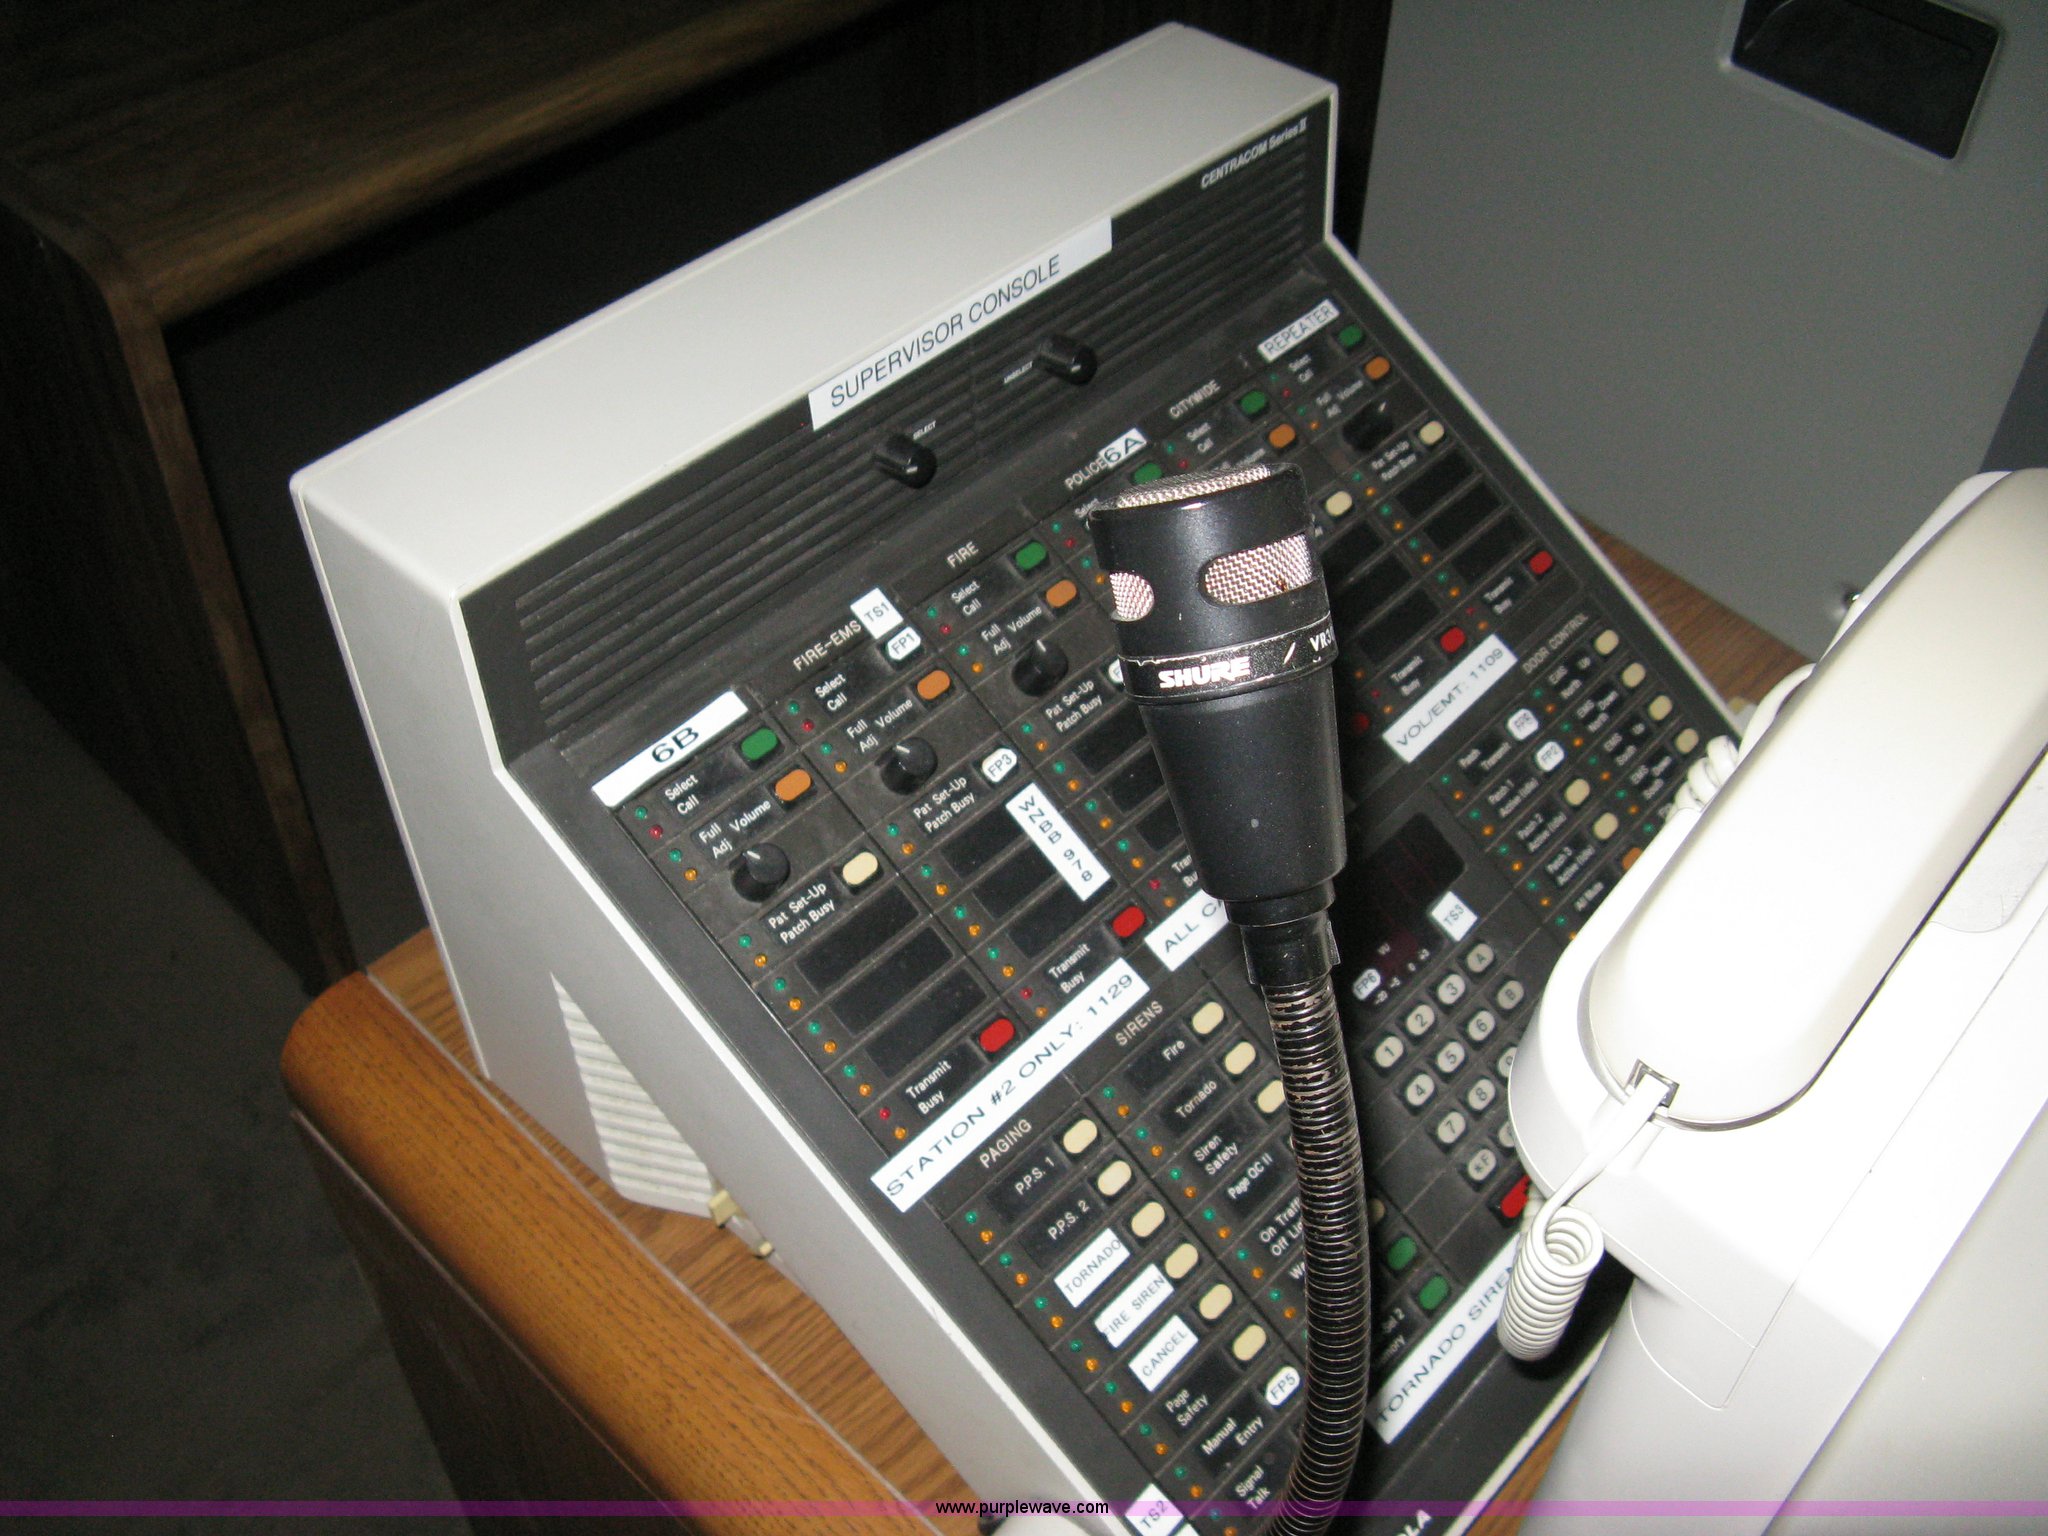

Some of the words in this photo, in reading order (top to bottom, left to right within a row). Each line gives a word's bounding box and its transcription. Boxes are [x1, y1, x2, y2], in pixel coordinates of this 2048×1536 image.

[1201, 141, 1268, 189] CENTRACOM
[1268, 127, 1299, 149] Series
[831, 313, 963, 408] SUPERVISOR
[969, 254, 1060, 324] CONSOLE
[1264, 305, 1334, 355] REPEATER
[1169, 379, 1221, 419] CITYWIDE
[1064, 457, 1108, 490] POLICE
[1104, 437, 1142, 463] 6A
[946, 541, 979, 568] FIRE
[951, 580, 981, 604] Select
[962, 598, 982, 617] Call
[864, 601, 890, 623] TS1
[981, 623, 1001, 643] Full
[1007, 604, 1043, 634] Volume
[793, 620, 862, 672] FIRE-EMS
[891, 632, 916, 655] FP1
[993, 637, 1012, 656] Adj
[1522, 646, 1549, 674] DOOR
[1549, 613, 1589, 650] CONTROL
[815, 673, 847, 699] Select
[1158, 656, 1250, 689] SHURE
[827, 692, 848, 712] Call
[1045, 701, 1064, 719] Pat
[1063, 679, 1095, 707] Set-Up
[1056, 709, 1083, 733] Patch
[1080, 693, 1104, 715] Busy
[1397, 684, 1470, 746] VOL/EMT:
[1470, 648, 1504, 680] 1109
[847, 719, 868, 740] Full
[875, 698, 914, 729] Volume
[651, 726, 699, 763] 6B
[859, 733, 879, 754] Adj
[988, 754, 1013, 777] FP3
[664, 774, 699, 801] Select
[914, 803, 934, 820] Pat
[933, 775, 968, 804] Set-Up
[677, 795, 699, 815] Call
[924, 807, 953, 833] Patch
[950, 791, 976, 817] Busy
[698, 823, 722, 844] Full
[729, 800, 771, 832] Volume
[712, 838, 733, 859] Adj
[1019, 795, 1062, 844] WZBB
[1063, 848, 1093, 883] 978
[768, 912, 789, 929] Pat
[789, 882, 827, 914] Set-Up
[780, 919, 810, 944] Patch
[808, 899, 835, 923] Busy
[1444, 904, 1464, 926] TS3
[1165, 922, 1199, 953] ALL
[1049, 943, 1091, 979] Transmit
[1060, 971, 1085, 994] Busy
[1356, 972, 1377, 994] FP6
[1446, 982, 1458, 996] 3
[1115, 1001, 1164, 1047] SIRENS
[1415, 1013, 1428, 1027] 2
[1476, 1019, 1487, 1032] 6
[1162, 1039, 1186, 1061] Fire
[1445, 1050, 1457, 1064] 5
[886, 1107, 985, 1197] STATION
[990, 1079, 1016, 1106] #2
[1019, 1020, 1083, 1078] ONLY:
[1086, 973, 1133, 1017] 1129
[906, 1060, 952, 1099] Transmit
[1415, 1084, 1426, 1096] 4
[1476, 1087, 1488, 1101] 8
[917, 1090, 945, 1115] Busy
[1175, 1080, 1218, 1119] Tornado
[978, 1118, 1033, 1168] PAGING
[1446, 1120, 1456, 1134] 7
[1194, 1134, 1222, 1162] Siren
[1205, 1142, 1238, 1175] Safety
[1014, 1167, 1047, 1195] P.P.S.
[1045, 1156, 1055, 1168] 1
[1227, 1177, 1250, 1199] Page
[1048, 1211, 1079, 1240] P.P.S.
[1078, 1200, 1090, 1213] 2
[1259, 1226, 1278, 1243] On
[1271, 1236, 1290, 1256] Off
[1064, 1238, 1122, 1295] TORNADO
[1103, 1310, 1131, 1338] FIRE
[1132, 1276, 1168, 1311] SIREN
[1141, 1329, 1189, 1377] CANCEL
[1270, 1373, 1296, 1400] FP5
[1376, 1323, 1466, 1424] TORNADO
[1165, 1388, 1191, 1413] Page
[1176, 1394, 1209, 1427] Safety
[1201, 1416, 1238, 1456] Manual
[1235, 1416, 1264, 1446] Entry
[1235, 1464, 1265, 1498] Signal
[1140, 1500, 1168, 1530] TS2
[1247, 1486, 1271, 1511] Talk
